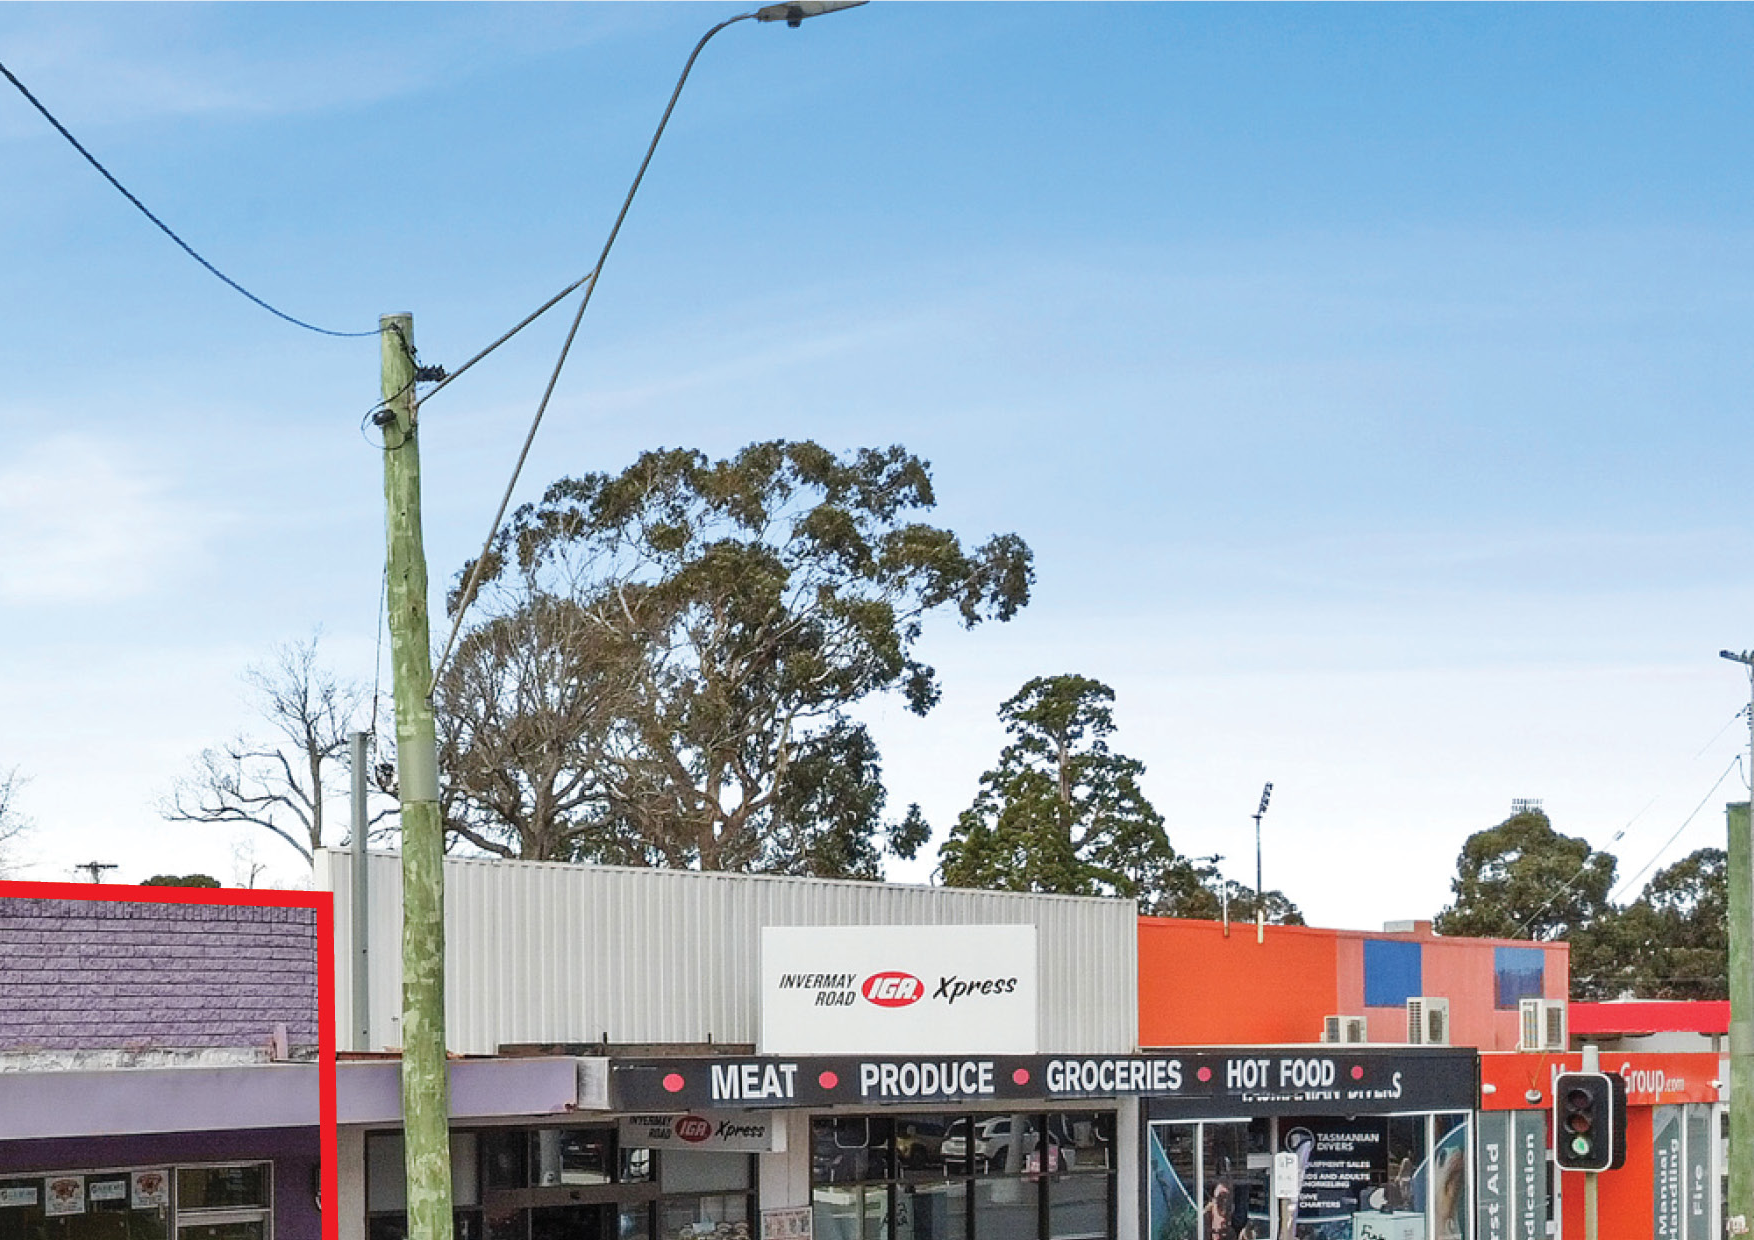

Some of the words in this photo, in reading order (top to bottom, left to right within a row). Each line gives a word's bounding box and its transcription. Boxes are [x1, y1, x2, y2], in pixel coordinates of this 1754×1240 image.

[779, 973, 857, 989] INVERMAY
[867, 977, 917, 1000] IGA
[932, 975, 1018, 1004] Xpress
[814, 991, 857, 1007] ROAD
[711, 1063, 798, 1100] MEAT
[859, 1061, 995, 1097] PRODUCE
[1046, 1059, 1183, 1092] GROCERIES
[1226, 1059, 1271, 1089] HOT
[1279, 1059, 1336, 1088] FOOD
[648, 1128, 672, 1140] ROAD
[679, 1119, 708, 1137] IGA
[714, 1120, 766, 1141] Xpress
[1316, 1133, 1380, 1142] TASMANIAN
[1316, 1142, 1355, 1152] DIVERS
[1485, 1142, 1499, 1195] Aid
[1658, 1148, 1667, 1235] Manual
[1692, 1164, 1703, 1216] Fire
[1299, 1201, 1341, 1209] CHARTERS
